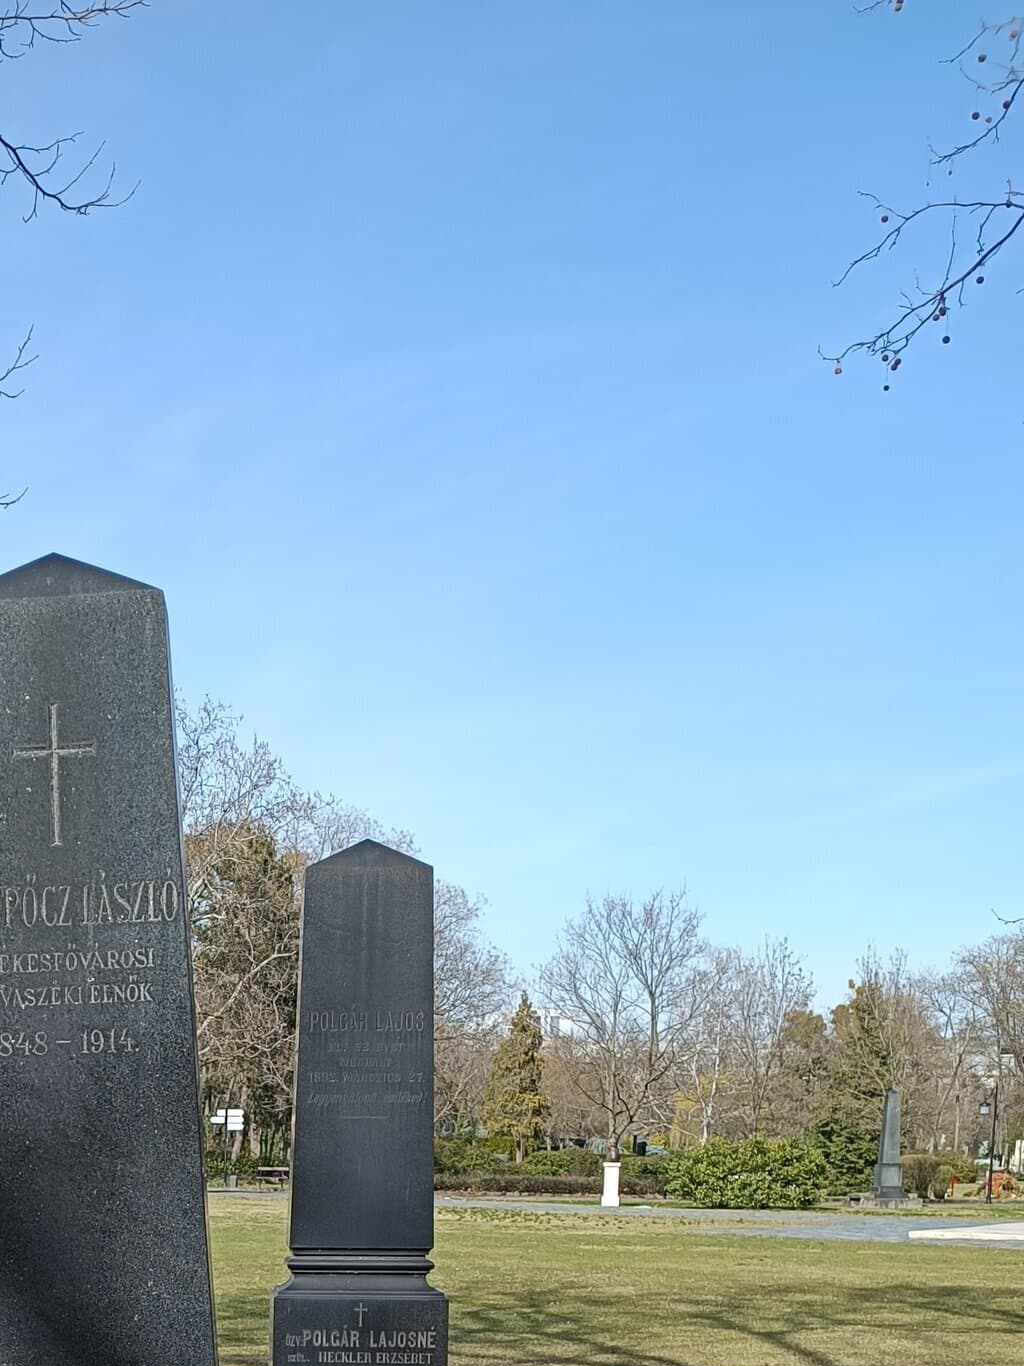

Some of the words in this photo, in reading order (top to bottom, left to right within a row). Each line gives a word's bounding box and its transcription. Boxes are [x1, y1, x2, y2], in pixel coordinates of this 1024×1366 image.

[81, 867, 178, 925] LÁSZLÓ
[376, 1009, 425, 1032] LAJOS
[303, 1325, 361, 1348] POLGÁR
[370, 1326, 437, 1349] LAJOSNÉ
[318, 1350, 372, 1364] HECKLER
[376, 1349, 434, 1365] ERZSÉBET
